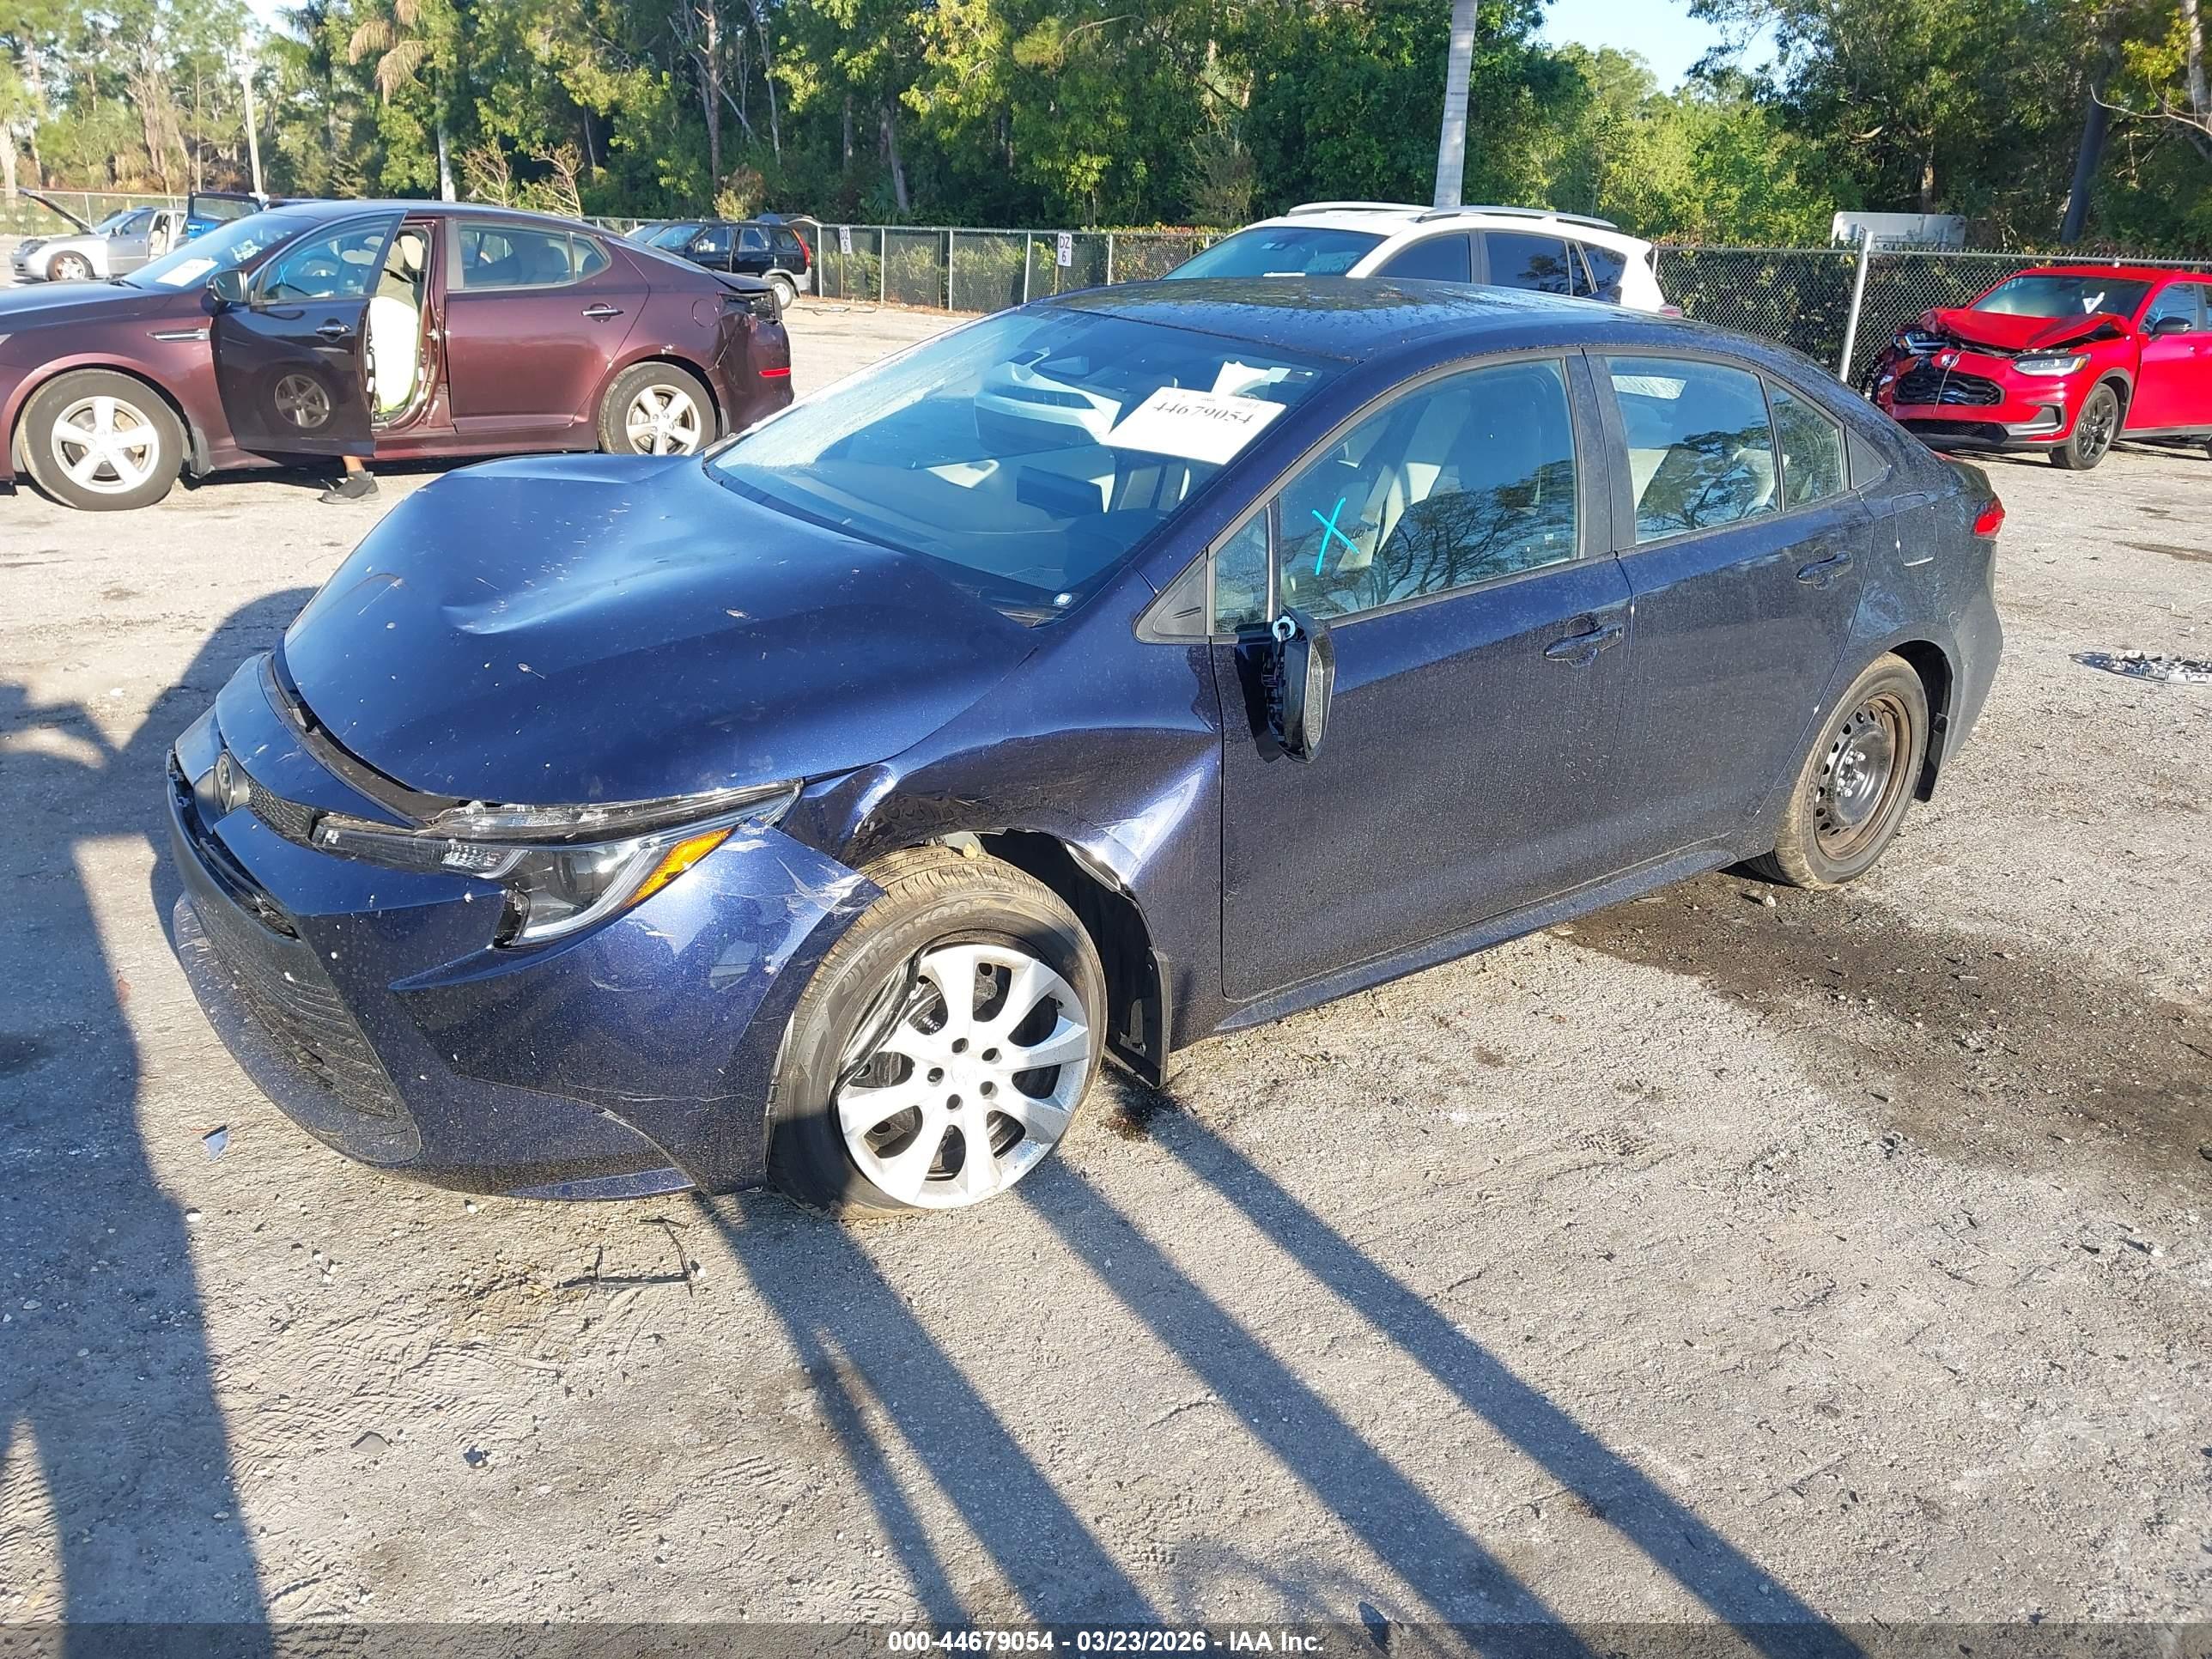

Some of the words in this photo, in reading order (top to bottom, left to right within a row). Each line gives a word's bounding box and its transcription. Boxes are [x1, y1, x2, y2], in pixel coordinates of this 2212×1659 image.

[1059, 236, 1071, 249] DZ
[1061, 250, 1066, 263] 6
[1152, 401, 1255, 425] 44679054
